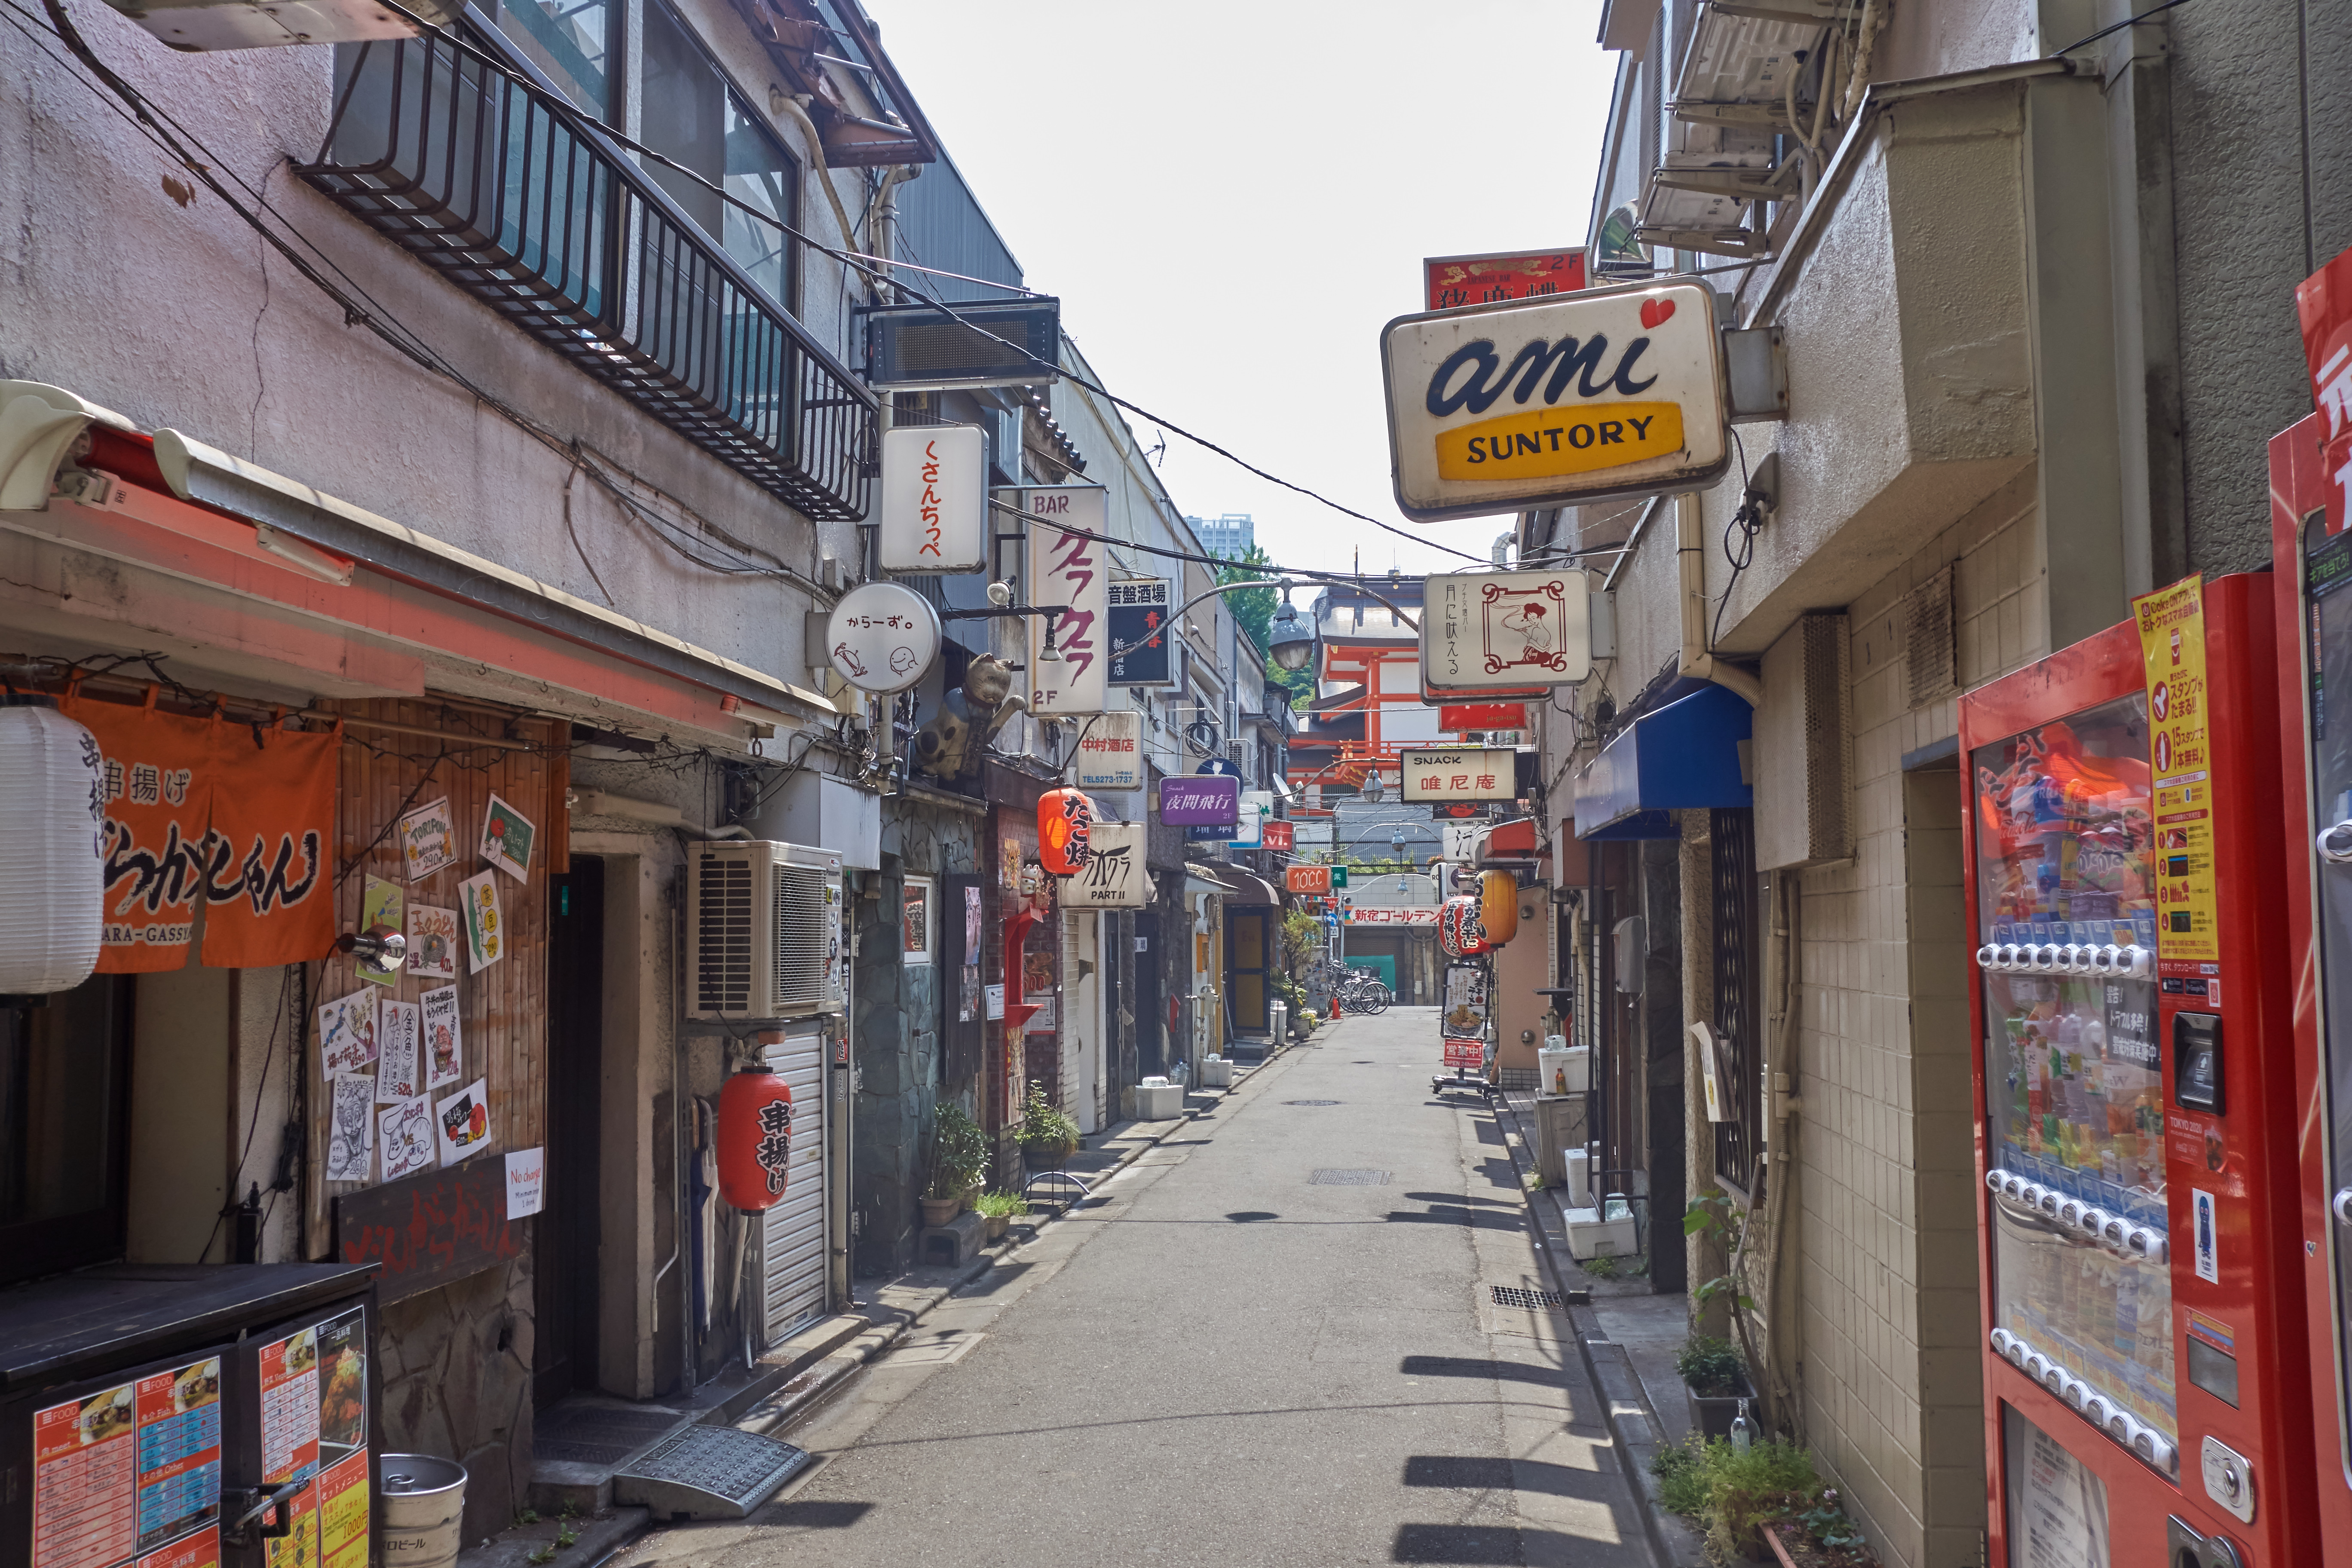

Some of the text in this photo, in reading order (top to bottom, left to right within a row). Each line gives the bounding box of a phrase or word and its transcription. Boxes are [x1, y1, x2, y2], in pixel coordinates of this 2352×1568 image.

[1551, 254, 1578, 270] 2F
[1468, 274, 1511, 284] JAPANESE BAR
[1427, 333, 1658, 417] ami
[1467, 416, 1654, 463] SUNTORY
[919, 440, 941, 557] くさんちっぺ
[1034, 496, 1069, 514] BAR
[1108, 584, 1166, 604] 音盤酒場
[2150, 599, 2168, 613] Coke
[1446, 585, 1458, 674] 月に吠える
[2171, 675, 2203, 701] スタンプが
[1033, 690, 1057, 705] 2F
[1486, 714, 1517, 722] ju-ga-tsu
[2172, 726, 2204, 747] 15スタンプで
[1082, 738, 1134, 752] 中村酒店
[1414, 756, 1461, 765] SNACK
[104, 762, 189, 803] 串揚げ
[1421, 775, 1495, 791] 唯尼庵
[1166, 794, 1232, 810] 夜間飛行
[410, 818, 446, 844] TORIPON
[1064, 796, 1090, 867] たこ焼
[1294, 870, 1323, 890] 10CC
[483, 888, 491, 903] 茶
[1091, 891, 1117, 900] PART
[488, 914, 495, 930] 豆
[1355, 909, 1440, 922] 新宿ゴールデン
[2107, 985, 2123, 1004] 警告!
[2110, 1010, 2148, 1033] トラブル多発!
[404, 1010, 415, 1057] 金魚
[1447, 1044, 1482, 1057] 営業中!
[2170, 1117, 2202, 1134] TOKYO 2020
[404, 1133, 413, 1146] VS
[760, 1102, 791, 1193] 串揚げ
[511, 1167, 541, 1185] No charge
[515, 1189, 532, 1199] Minimum
[522, 1200, 525, 1208] 1
[324, 1321, 337, 1332] FOOD
[270, 1344, 284, 1356] FOOD
[152, 1376, 172, 1390] FOOD
[53, 1406, 77, 1421] FOOD
[157, 1407, 171, 1418] Fish
[165, 1462, 184, 1473] Other
[326, 1468, 340, 1481] FOOD
[322, 1471, 363, 1500] セットメニュー
[343, 1509, 368, 1539] 1000円
[383, 1537, 426, 1550] ロビール
[151, 1550, 172, 1566] FOOD
